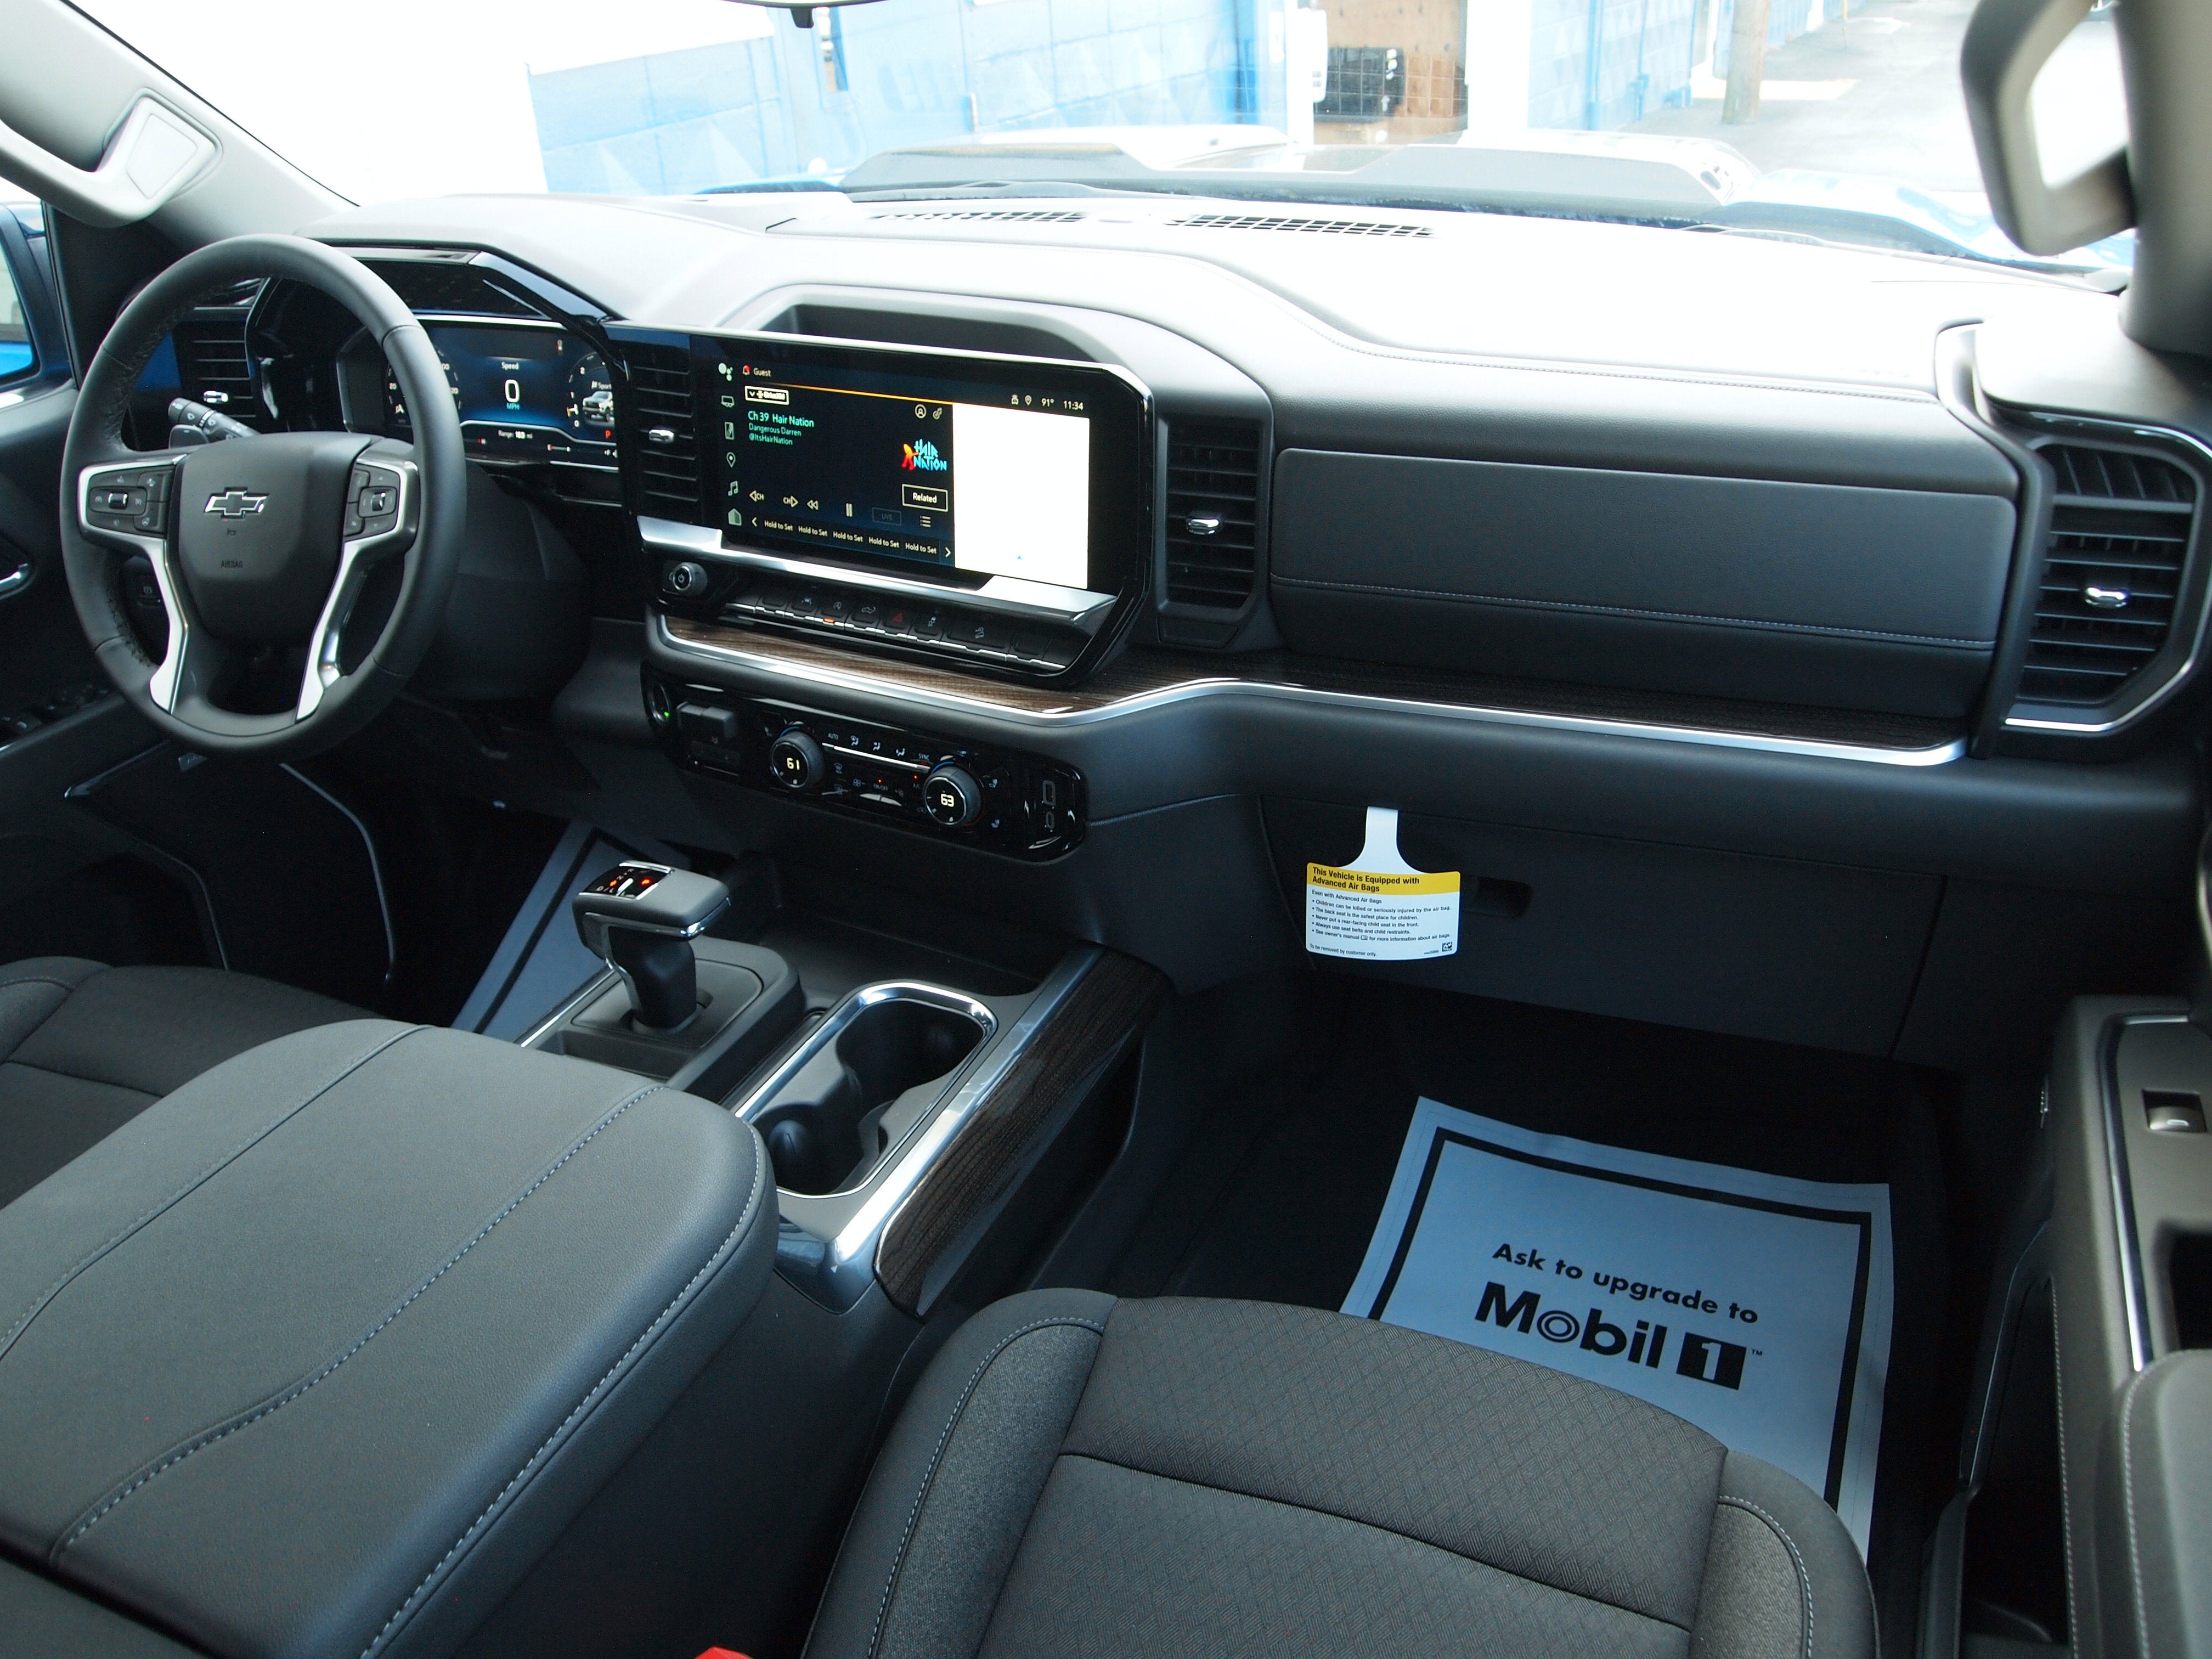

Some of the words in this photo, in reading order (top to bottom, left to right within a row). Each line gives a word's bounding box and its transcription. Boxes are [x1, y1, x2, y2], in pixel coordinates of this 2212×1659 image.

[501, 362, 518, 370] Speed
[753, 368, 771, 377] Guest
[505, 379, 520, 403] 0
[1063, 400, 1084, 410] 11:34
[748, 411, 758, 421] Ch
[759, 412, 769, 421] 39
[772, 413, 787, 424] Hair
[789, 415, 814, 427] Nation
[605, 430, 612, 439] P
[749, 422, 780, 433] Dangerous
[781, 426, 802, 437] Darren
[749, 433, 793, 445] @ItsHairNation
[783, 496, 791, 505] CH
[912, 492, 937, 504] Related
[764, 520, 777, 529] Hold
[798, 526, 811, 534] Hold
[833, 531, 846, 539] Hold
[854, 534, 863, 543] Set
[869, 537, 882, 545] Hold
[890, 540, 900, 549] Set
[905, 543, 919, 551] Hold
[927, 546, 937, 554] Set
[787, 757, 800, 771] 61
[940, 793, 955, 808] 63
[1313, 866, 1327, 876] This
[1328, 870, 1355, 881] Vehicle
[1365, 875, 1401, 885] Equipped
[1313, 876, 1346, 888] Advanced
[1361, 884, 1380, 893] Bags
[1316, 899, 1335, 907] Children
[1492, 1243, 1547, 1271] Ask
[1555, 1259, 1583, 1280] to
[1593, 1271, 1718, 1314] upgrade
[1729, 1302, 1759, 1324] to
[1474, 1281, 1668, 1369] Mobil
